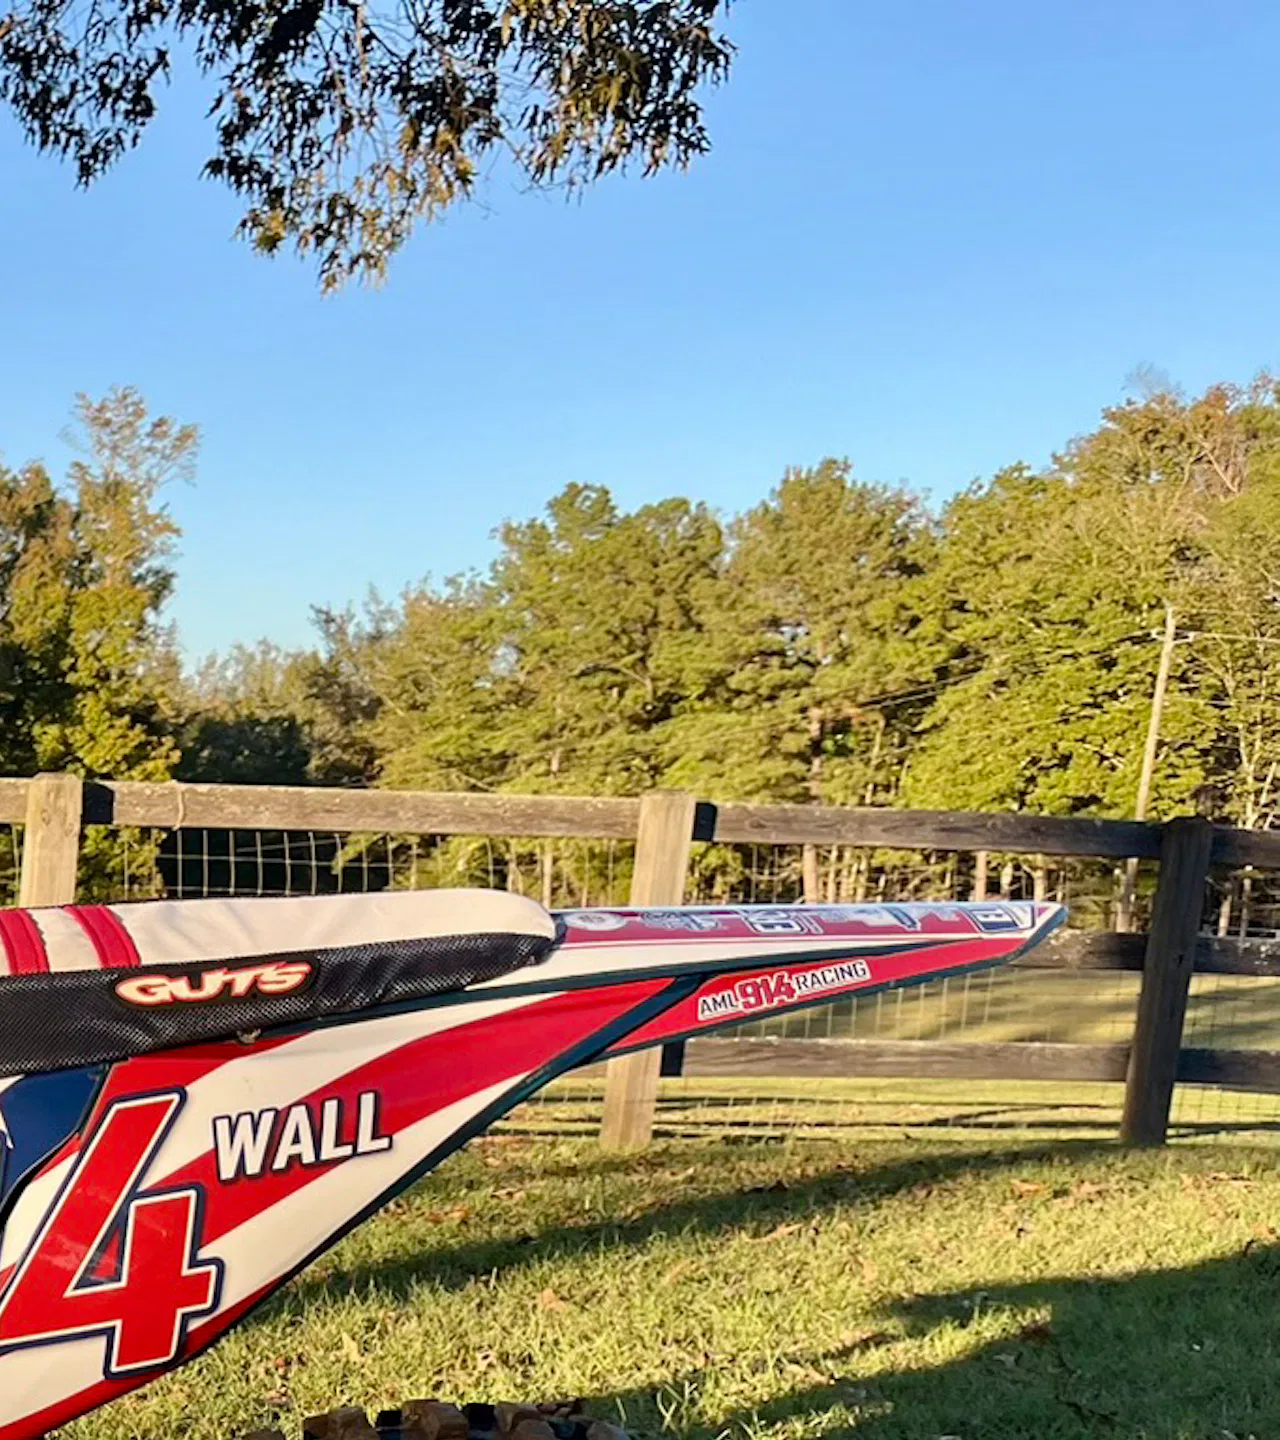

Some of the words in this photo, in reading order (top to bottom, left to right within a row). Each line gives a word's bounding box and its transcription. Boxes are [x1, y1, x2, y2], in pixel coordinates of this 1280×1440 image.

[114, 960, 312, 1006] GUTS
[700, 992, 739, 1016] AML
[738, 974, 796, 1011] 914
[794, 961, 868, 991] RACING
[213, 1091, 393, 1183] WALL
